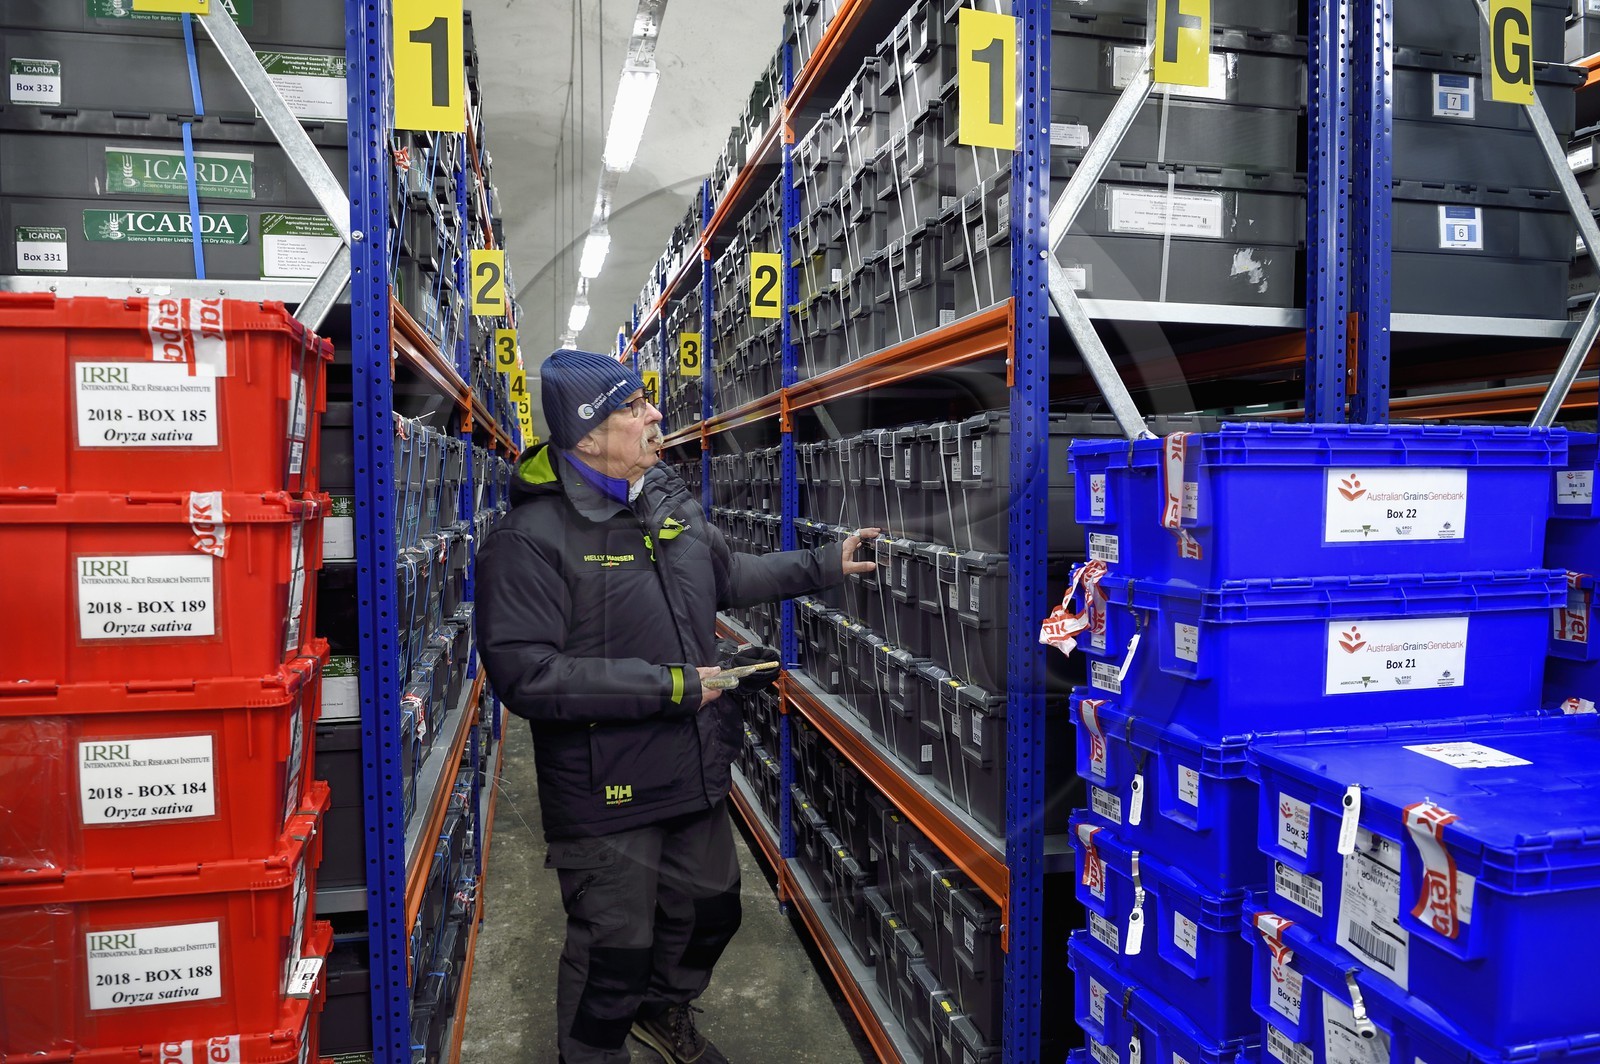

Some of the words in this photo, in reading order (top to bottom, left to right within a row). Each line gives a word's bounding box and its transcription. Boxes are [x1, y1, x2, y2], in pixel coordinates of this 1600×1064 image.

[1494, 7, 1530, 86] G
[23, 66, 55, 74] ICARDA
[409, 17, 450, 107] 1
[16, 83, 34, 91] Box
[36, 84, 54, 92] 332
[972, 38, 1004, 125] 1
[1451, 97, 1457, 106] 7
[144, 159, 248, 184] ICARDA
[127, 213, 235, 234] ICARDA
[1458, 228, 1464, 238] 6
[23, 253, 42, 261] Box
[43, 253, 62, 261] 331
[475, 262, 500, 305] 2
[755, 265, 778, 307] 2
[498, 337, 515, 365] 3
[683, 340, 698, 368] 3
[82, 366, 128, 383] IRRI
[81, 383, 131, 391] INTERNATIONAL
[147, 384, 179, 392] RESEARCH
[512, 375, 524, 396] 4
[519, 397, 528, 414] 5
[88, 409, 122, 421] 2018
[138, 409, 176, 421] BOX
[182, 409, 207, 421] 185
[104, 428, 146, 444] Oryza
[151, 429, 193, 441] sativa
[1387, 509, 1403, 518] Box
[1406, 509, 1417, 518] 22
[606, 554, 635, 562] HANSEN
[82, 560, 128, 576] IRRI
[131, 576, 146, 584] RICE
[147, 576, 179, 584] RESEARCH
[180, 576, 210, 584] INSTITUTE
[87, 602, 122, 614] 2018
[137, 601, 175, 613] BOX
[181, 600, 206, 612] 189
[103, 621, 145, 636] Oryza
[150, 620, 192, 632] sativa
[1386, 660, 1403, 669] Box
[1405, 659, 1416, 668] 21
[85, 744, 131, 761] IRRI
[84, 761, 131, 769] INTERNATIONAL
[148, 758, 180, 766] RESEARCH
[180, 756, 210, 764] INSTITUTE
[88, 787, 123, 800] 2018
[138, 783, 176, 797] BOX
[182, 782, 207, 795] 184
[605, 785, 632, 799] HH
[104, 806, 146, 820] Oryza
[151, 803, 193, 815] sativa
[1286, 823, 1300, 836] Box
[90, 933, 136, 951] IRRI
[89, 950, 138, 959] INTERNATIONAL
[154, 946, 185, 954] RESEARCH
[186, 942, 216, 951] INSTITUTE
[96, 973, 130, 986] 2018
[145, 968, 182, 983] BOX
[188, 965, 213, 978] 188
[112, 991, 153, 1005] Oryza
[158, 986, 199, 999] sativa
[1277, 987, 1291, 1003] Box
